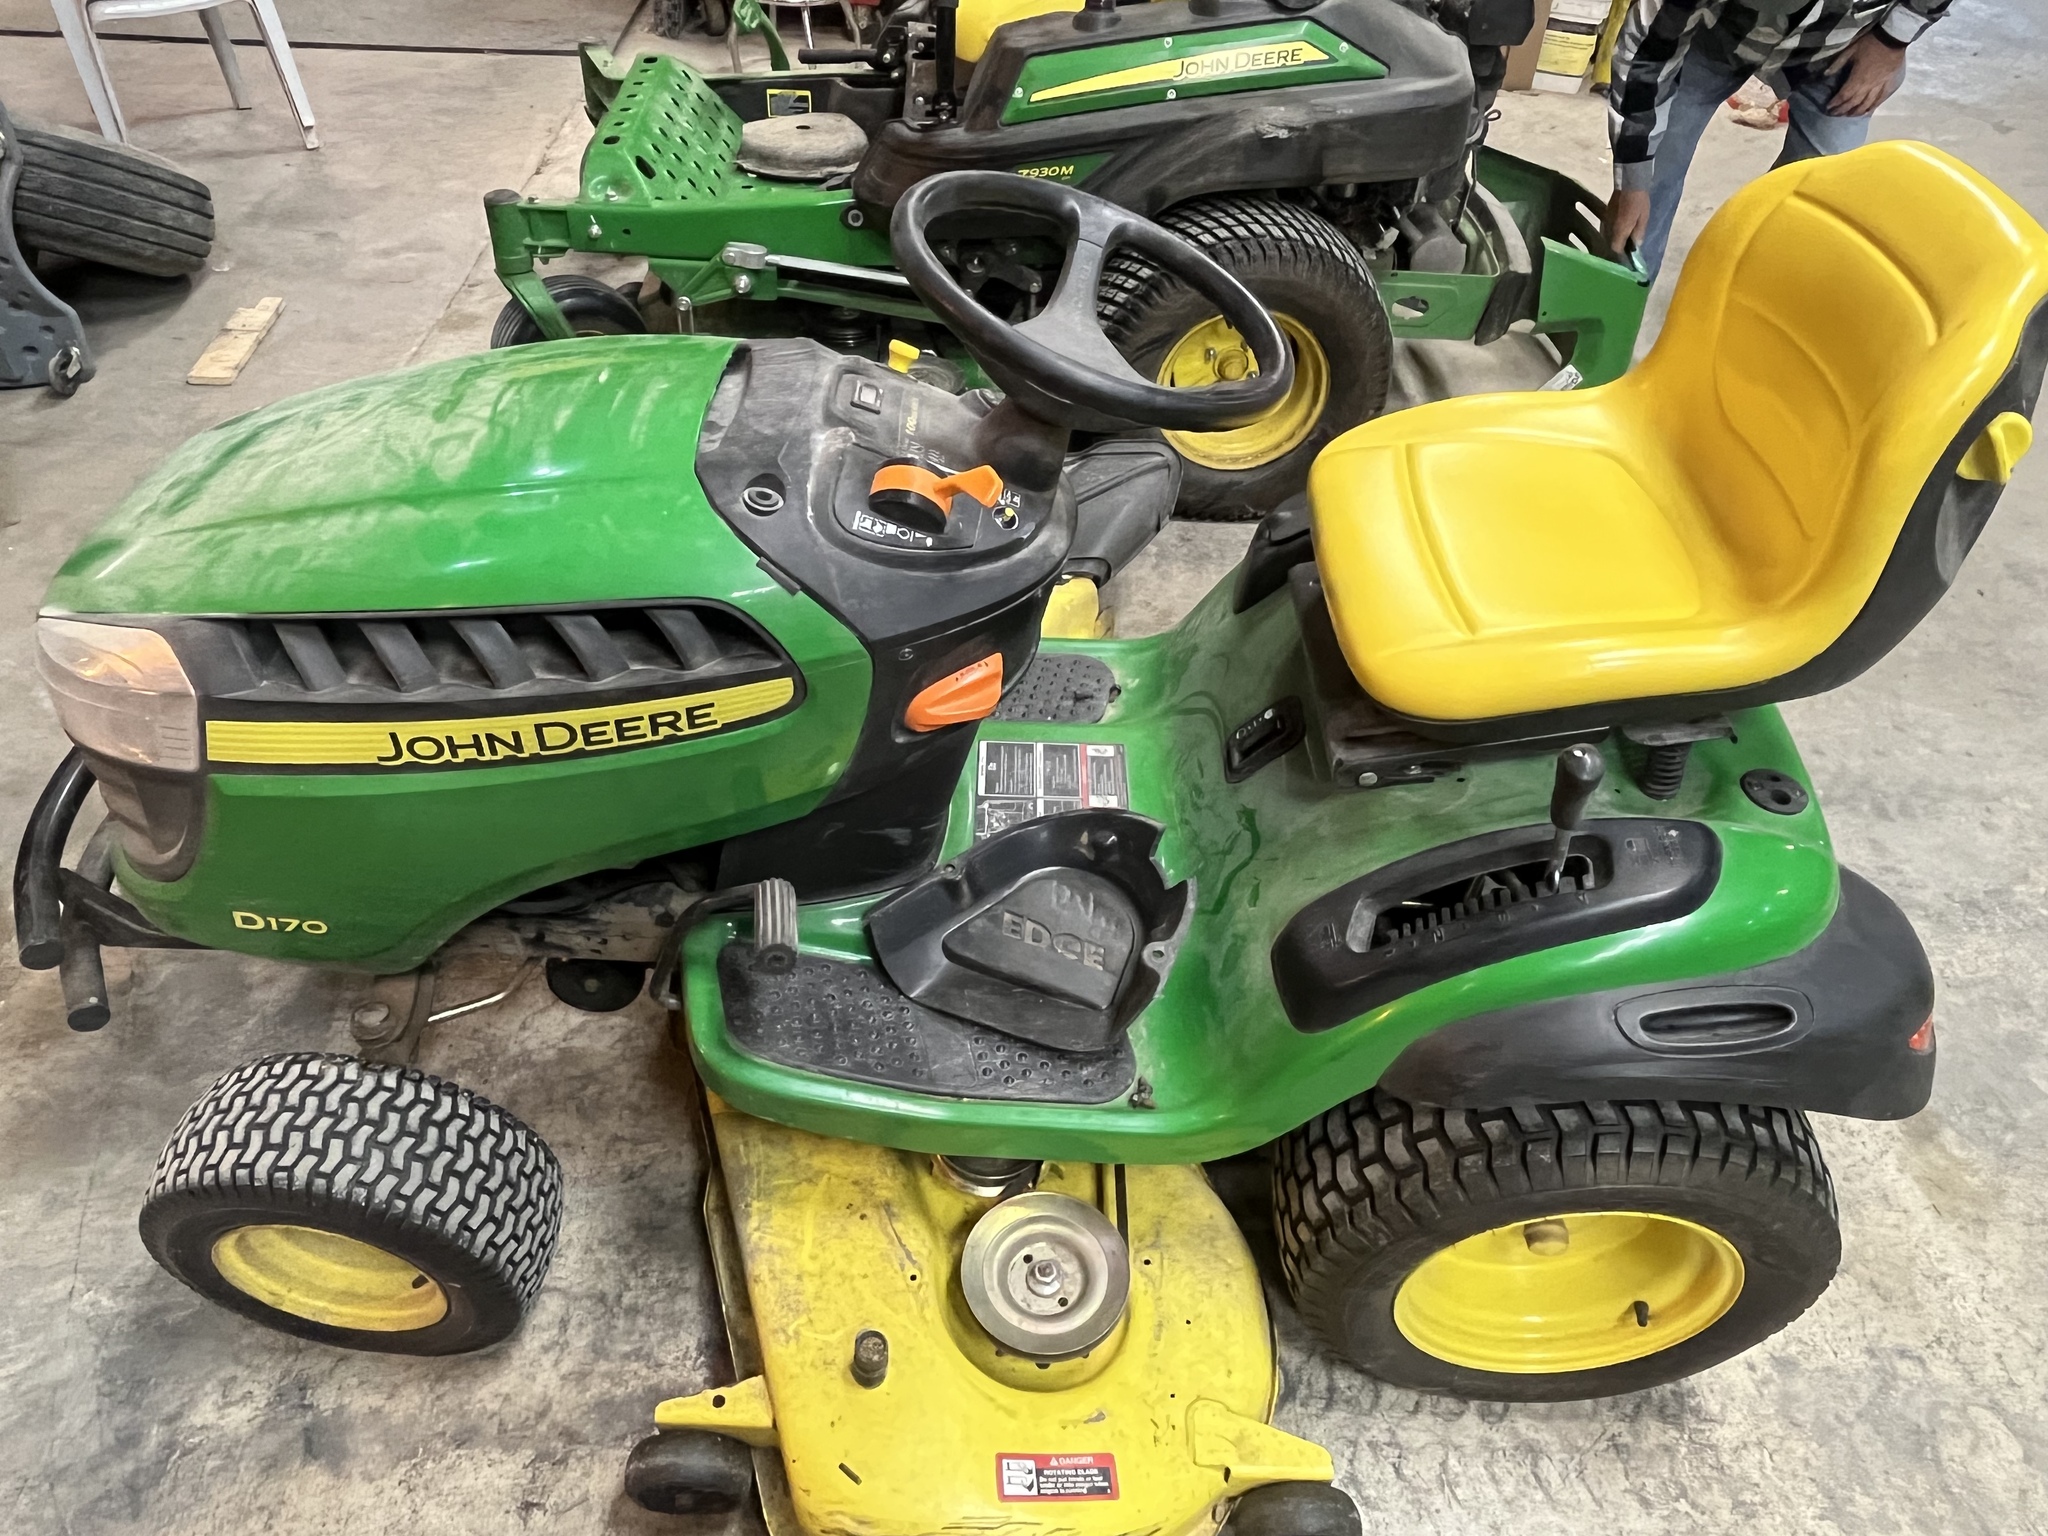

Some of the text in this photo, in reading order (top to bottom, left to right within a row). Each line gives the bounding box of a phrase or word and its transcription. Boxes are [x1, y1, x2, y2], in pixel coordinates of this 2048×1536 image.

[1173, 48, 1303, 78] JOHN DEERE
[377, 703, 718, 762] JOHN DEERE
[232, 911, 328, 934] D170
[1002, 910, 1105, 971] EDGE
[1058, 1456, 1094, 1465] DANGER
